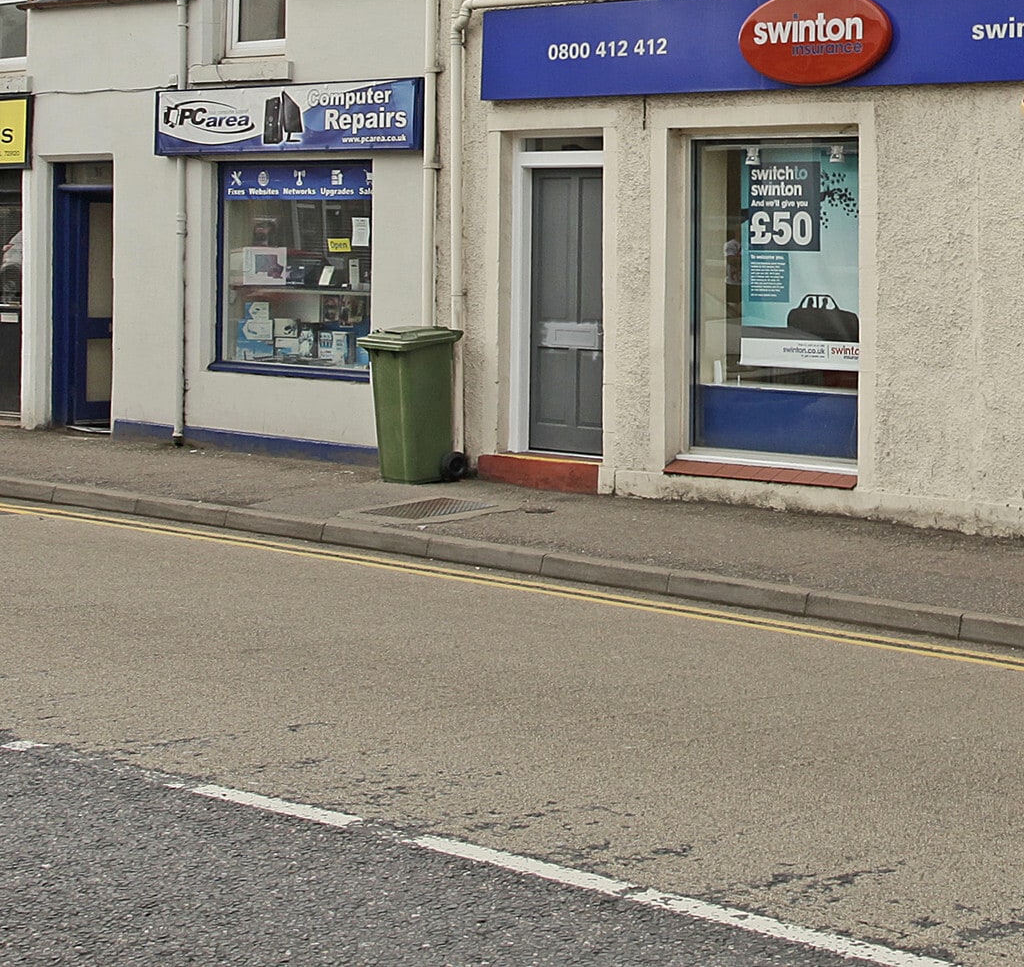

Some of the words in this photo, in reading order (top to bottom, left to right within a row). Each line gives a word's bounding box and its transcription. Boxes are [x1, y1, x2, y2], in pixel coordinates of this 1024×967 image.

[753, 12, 863, 45] swinton
[548, 42, 590, 60] 0800
[595, 40, 628, 58] 412
[634, 38, 668, 56] 412
[792, 42, 862, 56] insurance
[308, 88, 392, 109] Computer
[324, 107, 407, 134] Repairs
[342, 134, 407, 144] www.pcarea.co.uk
[228, 188, 245, 196] Fixes
[249, 188, 279, 196] Websites
[283, 188, 316, 196] Networks
[320, 188, 354, 197] Upgrades
[751, 181, 802, 196] swinton
[751, 199, 764, 207] And
[781, 199, 795, 209] give
[796, 200, 808, 209] you
[750, 211, 812, 246] £50
[330, 240, 348, 250] Open
[783, 346, 825, 354] swinton.co.uk
